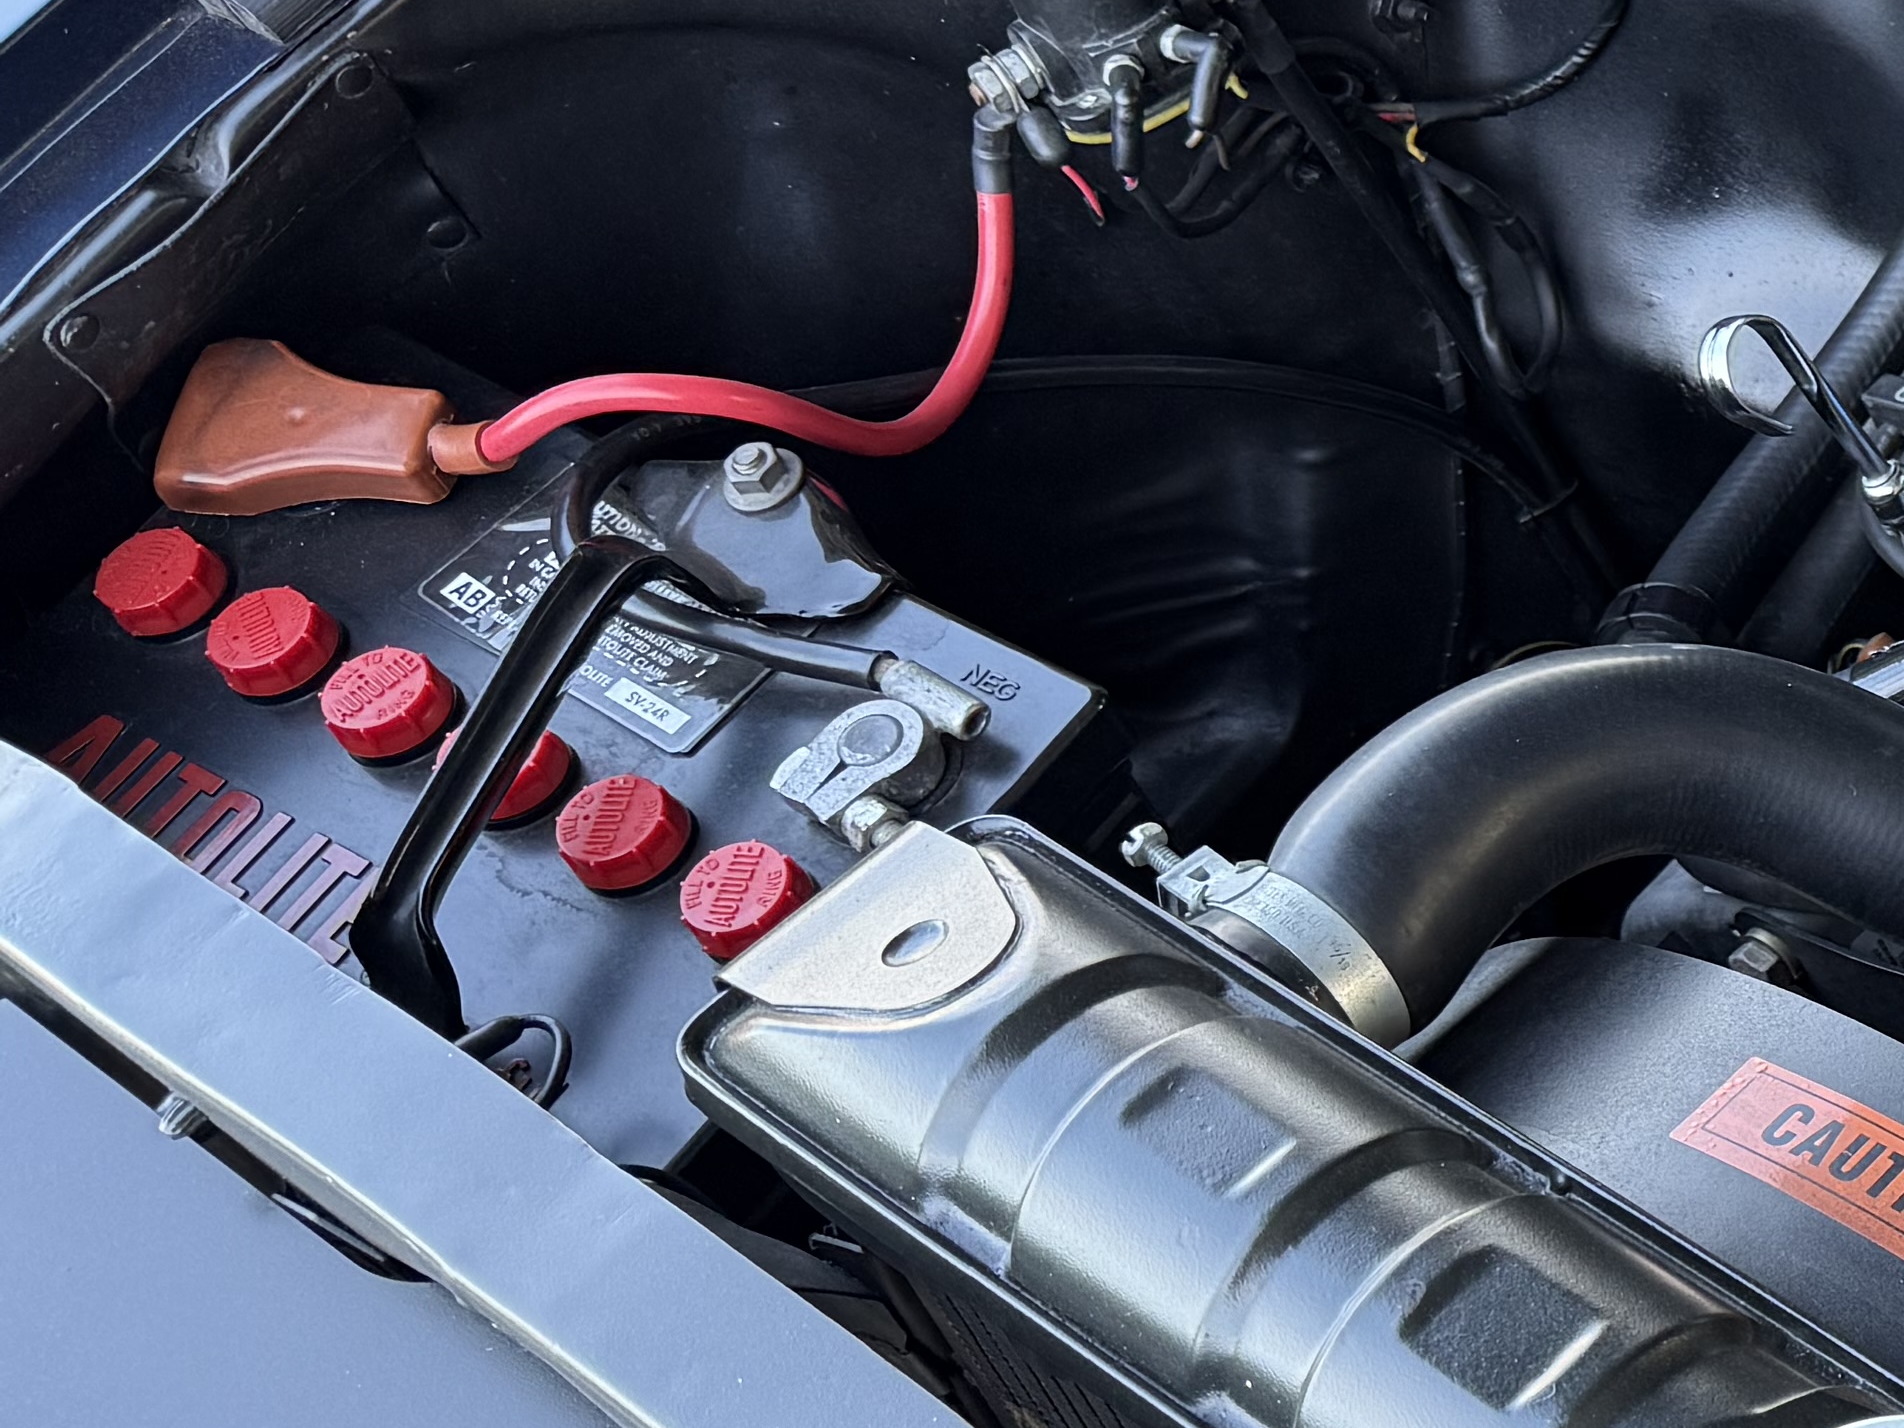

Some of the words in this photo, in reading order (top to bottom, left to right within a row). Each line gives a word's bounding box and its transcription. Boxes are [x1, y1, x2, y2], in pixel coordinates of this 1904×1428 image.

[449, 580, 484, 609] AB
[329, 659, 361, 692] FILL
[360, 651, 386, 670] TO
[650, 648, 675, 668] AND
[960, 663, 1021, 702] NEG
[330, 651, 424, 724] AUTOLITE
[579, 663, 614, 689] OLITE
[624, 690, 672, 723] SV-24R
[562, 811, 580, 843] FILL
[575, 791, 595, 810] TO
[582, 776, 638, 858] AUTOLITE
[684, 878, 704, 911] FILL
[698, 857, 721, 878] TO
[704, 843, 766, 928] AUTOLITE
[755, 868, 783, 910] RING
